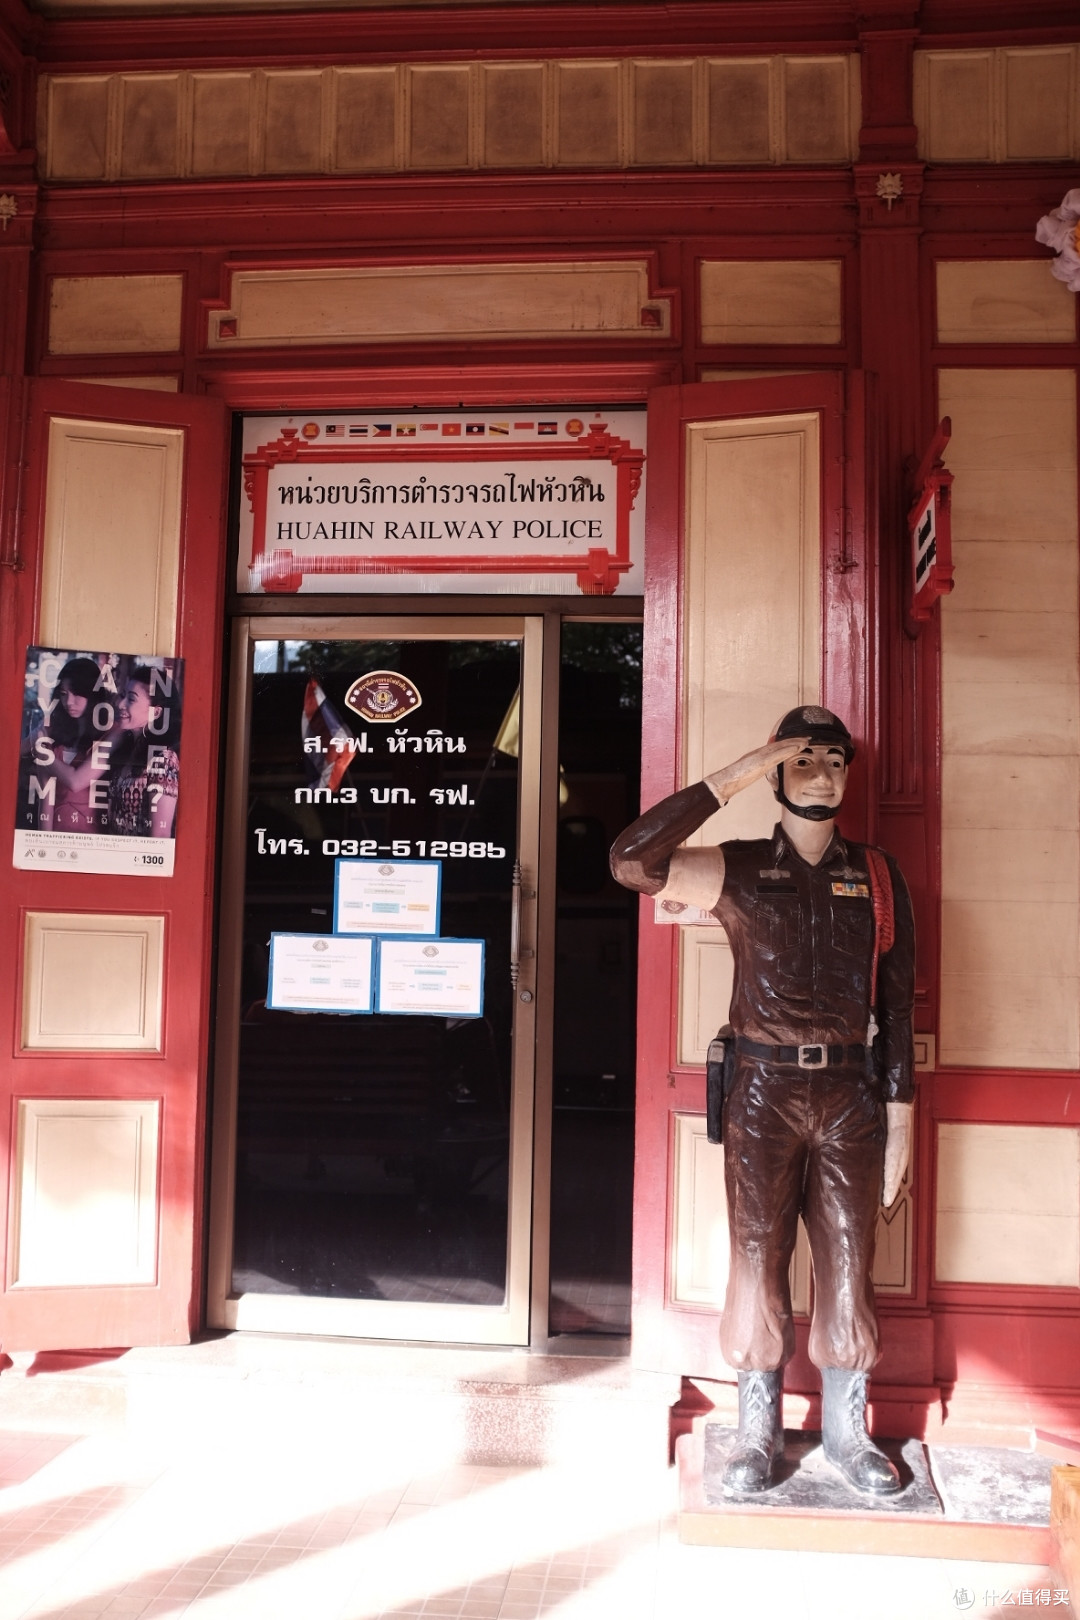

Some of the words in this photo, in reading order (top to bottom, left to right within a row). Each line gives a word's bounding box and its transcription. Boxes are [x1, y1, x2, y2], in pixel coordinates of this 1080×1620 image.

[278, 472, 605, 504] หน่วยบริการตำรวจรถไฟหัวหิน
[277, 521, 375, 540] HUAHIN
[384, 520, 503, 539] RAILWAY
[512, 519, 603, 539] POLICE
[303, 732, 374, 754] ส.รฟ.
[386, 728, 467, 754] หัวหิน
[294, 787, 358, 804] กก.3
[369, 787, 416, 805] บก.
[429, 784, 475, 806] รฟ.
[254, 828, 310, 855] โทร.
[142, 855, 164, 865] 1300
